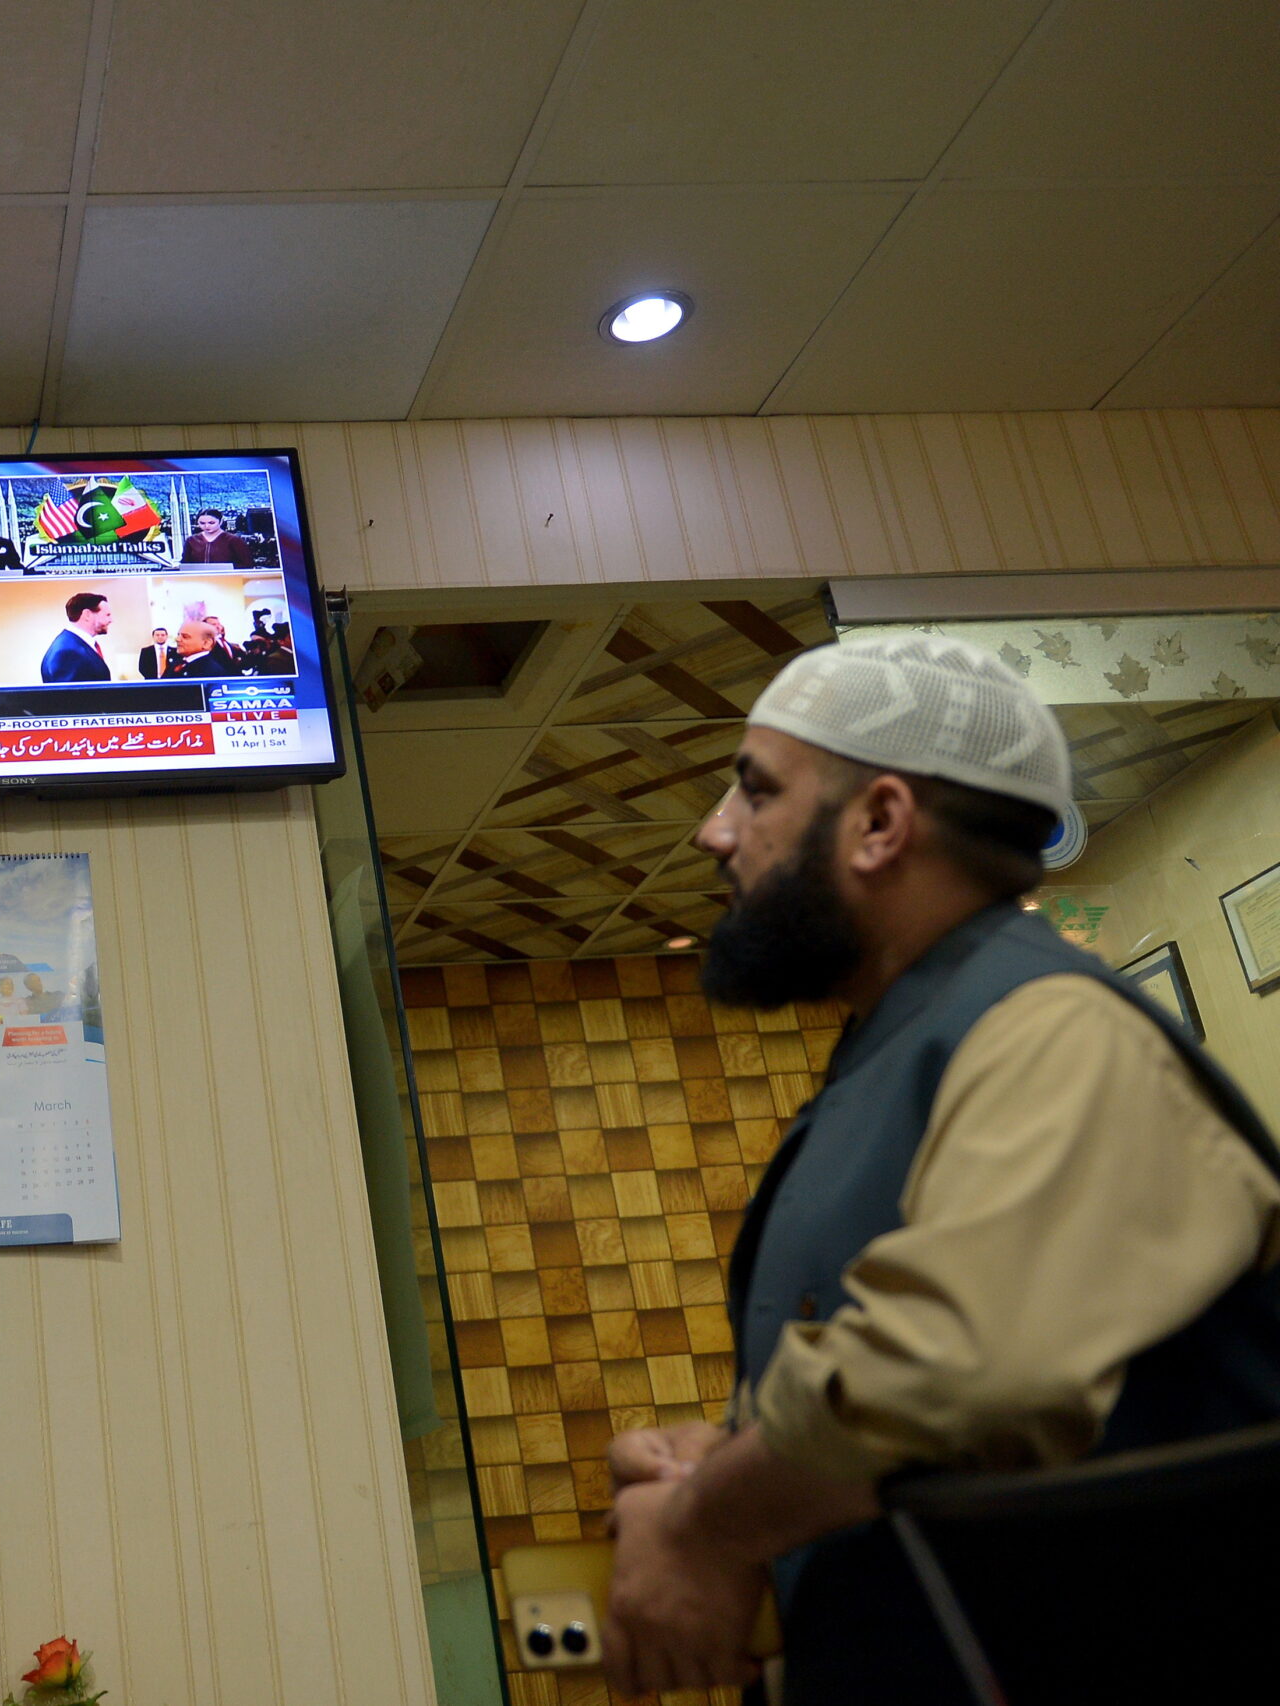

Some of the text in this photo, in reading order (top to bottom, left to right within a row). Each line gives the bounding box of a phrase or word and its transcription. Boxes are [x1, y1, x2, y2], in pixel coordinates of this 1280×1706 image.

[35, 541, 161, 555] Islamabad Talks
[212, 698, 293, 710] SAMAA
[73, 716, 152, 727] FRATERNAL
[156, 714, 203, 724] BONDS
[226, 710, 281, 722] LIVE
[243, 740, 260, 749] Apr
[269, 739, 286, 747] Sat
[2, 777, 37, 785] SONY
[34, 1099, 72, 1111] March
